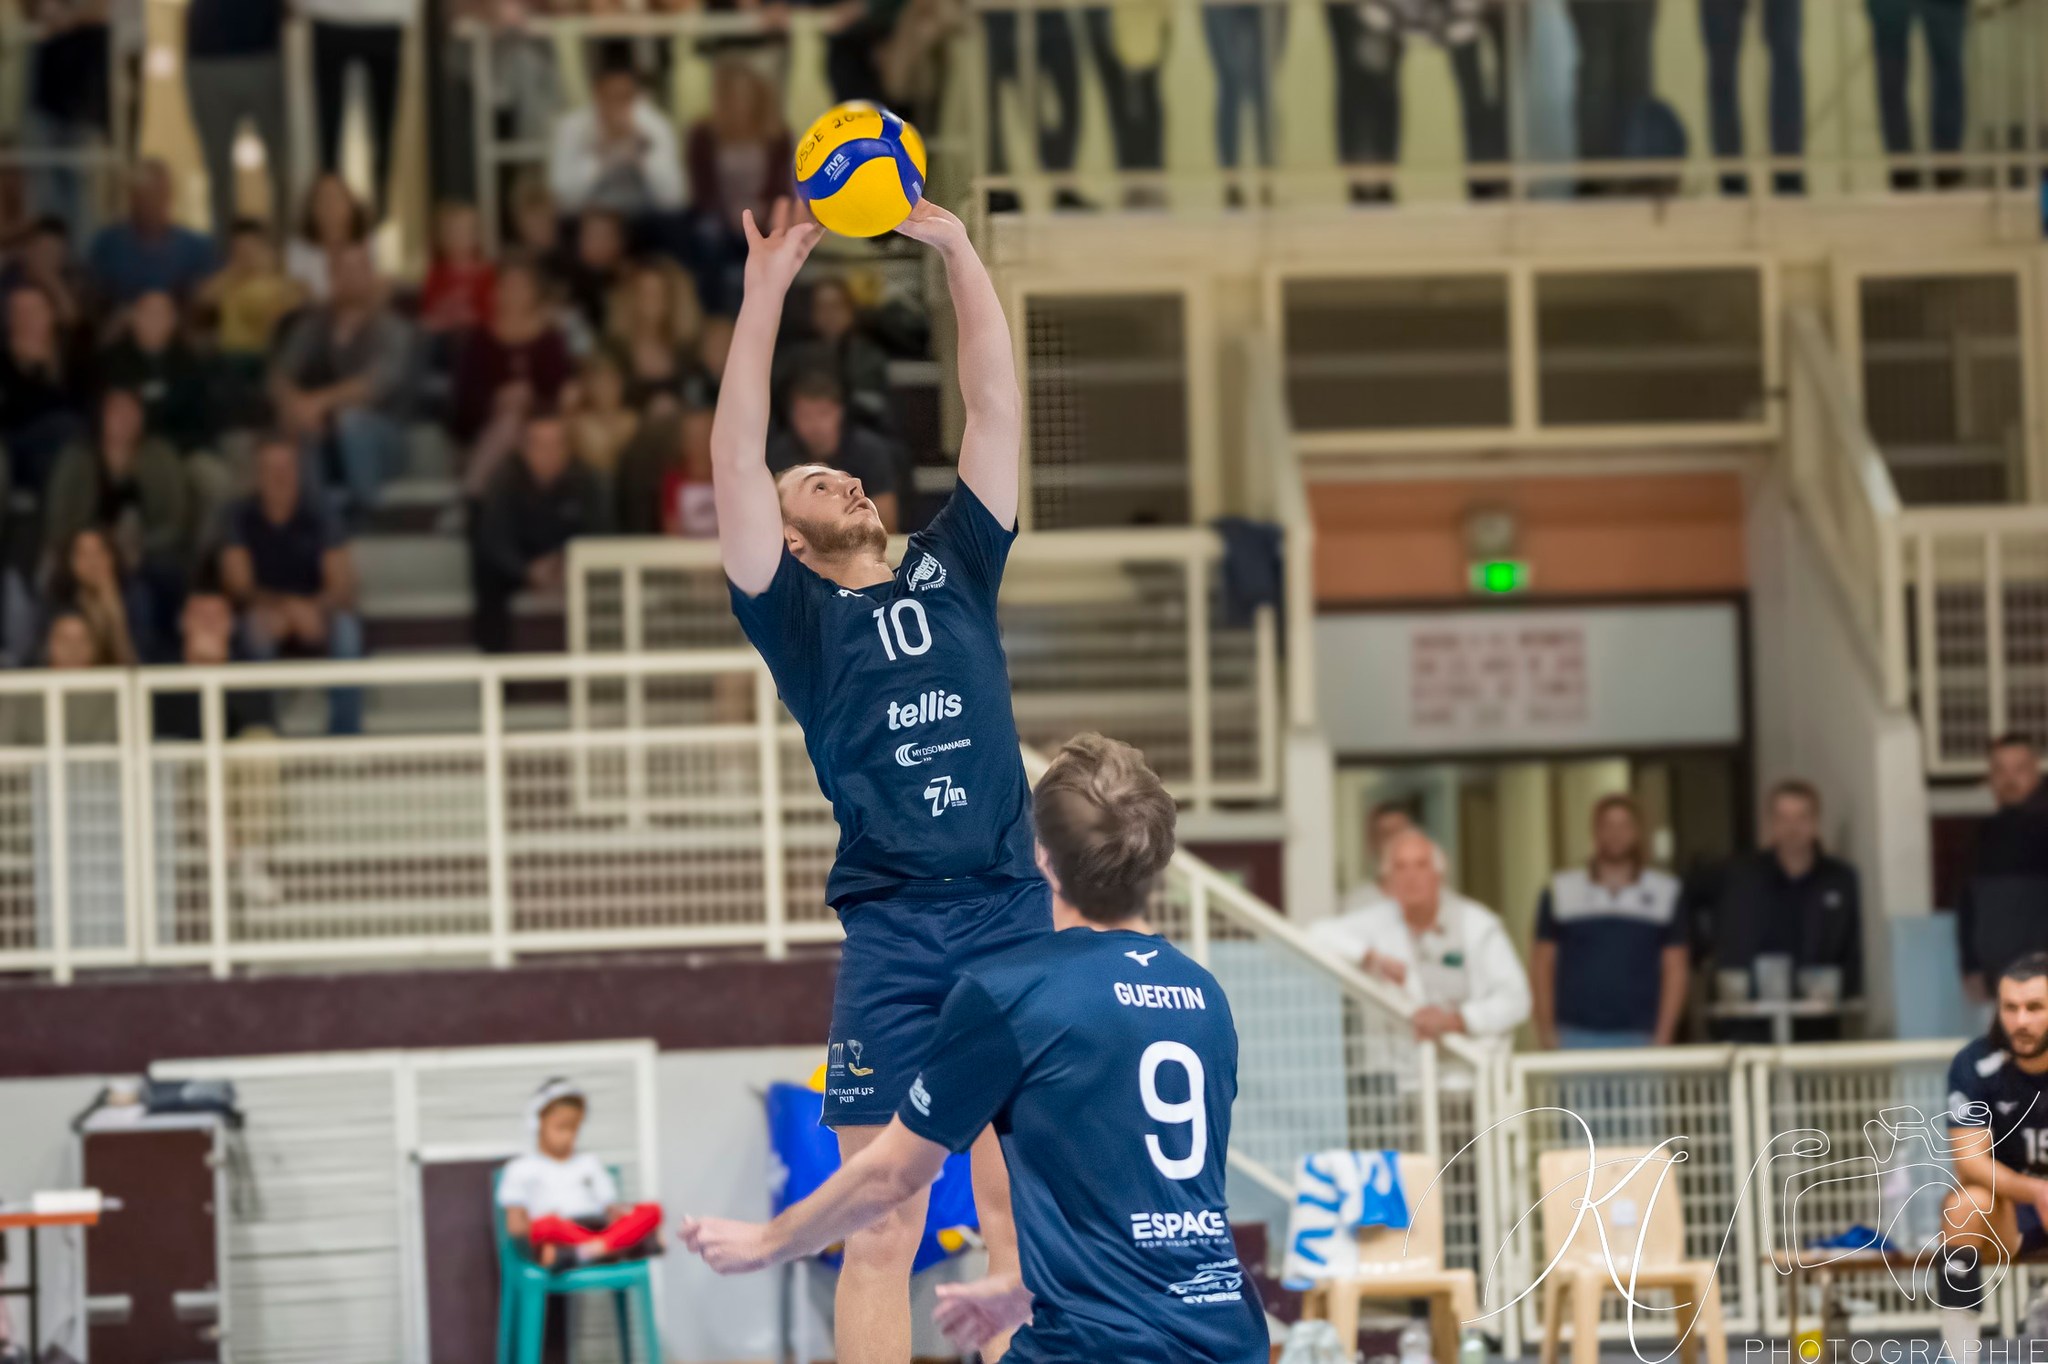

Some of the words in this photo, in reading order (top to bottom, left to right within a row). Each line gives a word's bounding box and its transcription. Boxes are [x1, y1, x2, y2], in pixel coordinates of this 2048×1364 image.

[824, 153, 846, 176] FIVB
[873, 599, 932, 661] 10
[887, 690, 962, 730] tellis
[1113, 982, 1206, 1010] GUERTIN
[839, 1096, 855, 1104] PUB
[1139, 1040, 1207, 1180] 9
[1130, 1210, 1225, 1240] ESPACE
